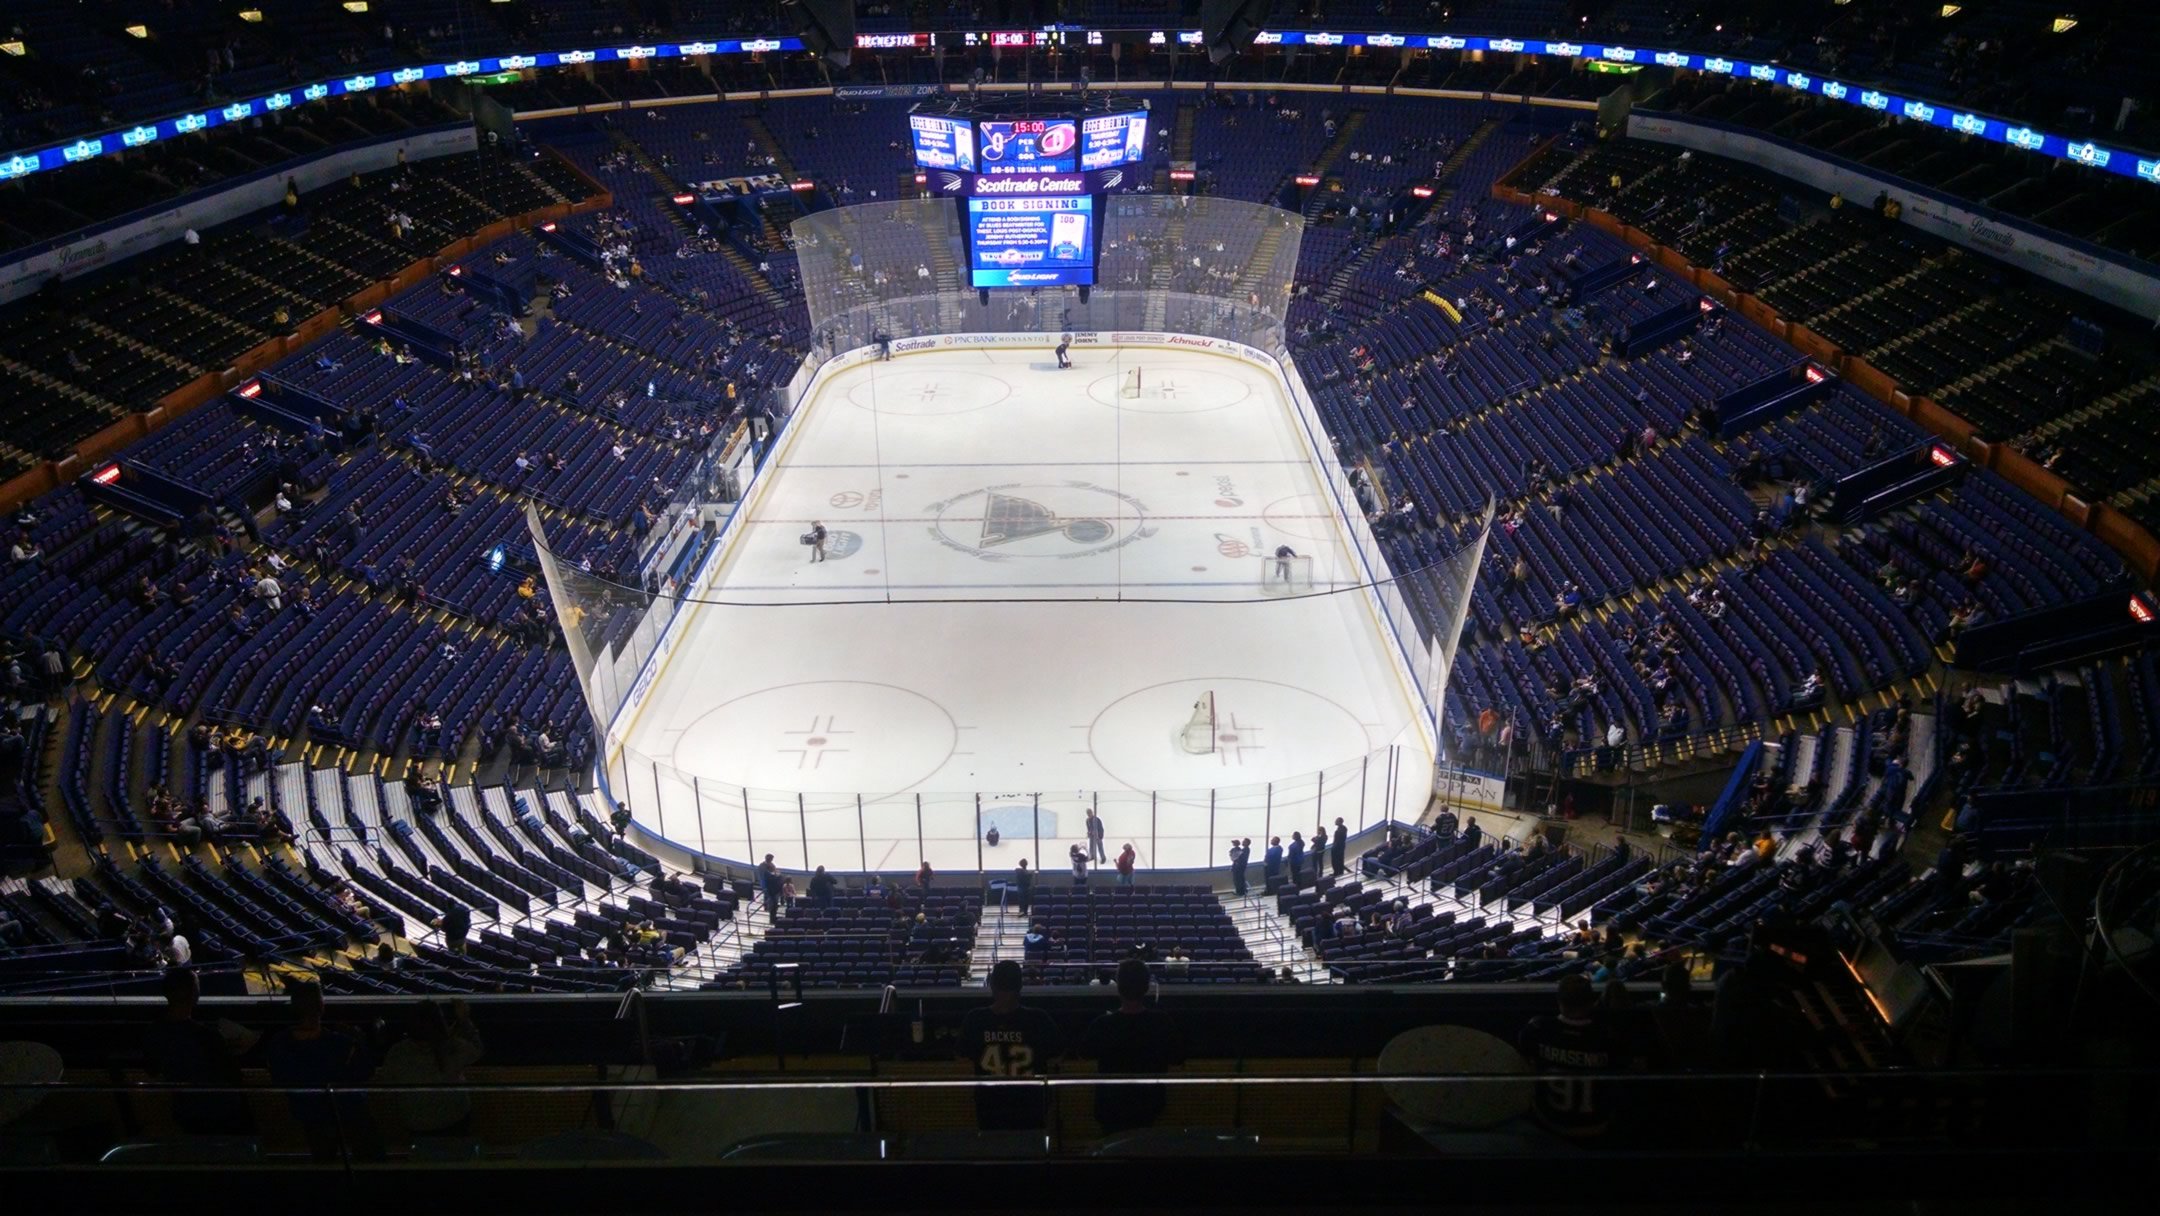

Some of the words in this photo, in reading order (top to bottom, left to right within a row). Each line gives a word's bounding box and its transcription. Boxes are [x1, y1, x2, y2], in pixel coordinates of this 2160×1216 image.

[995, 34, 1024, 45] 15:00
[916, 85, 938, 95] ZONE
[1014, 122, 1044, 132] 15:00
[976, 177, 1038, 193] Scottrade
[1039, 176, 1082, 191] Center
[981, 201, 1015, 210] BOOK
[1022, 199, 1079, 210] SIGNING
[895, 339, 937, 352] Scottrade
[954, 336, 974, 345] PNC
[974, 335, 998, 344] BANK
[998, 336, 1044, 344] MONSANTO
[1166, 335, 1215, 348] Schnucks
[632, 657, 658, 708] GEICO
[983, 1031, 1023, 1043] BACKES
[980, 1043, 1035, 1077] 42
